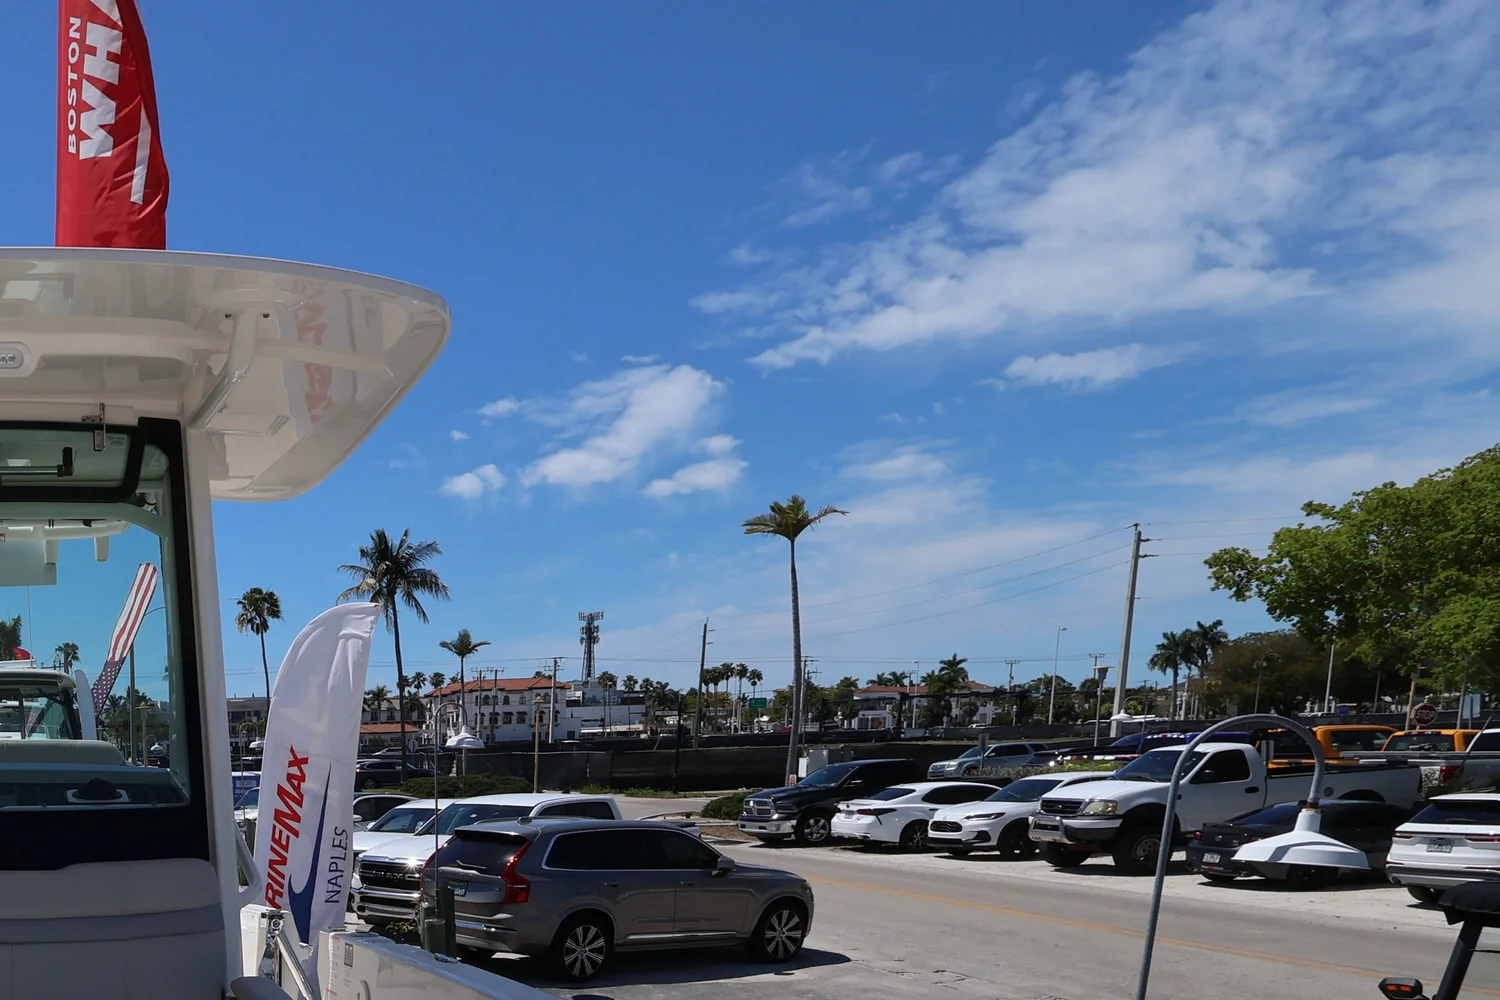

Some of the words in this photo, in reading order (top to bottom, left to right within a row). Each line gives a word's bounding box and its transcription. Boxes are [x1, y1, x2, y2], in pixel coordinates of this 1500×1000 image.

[67, 16, 82, 154] BOSTON
[79, 0, 123, 160] WH
[1415, 709, 1435, 720] STOP
[265, 745, 309, 910] RINEMAX
[324, 826, 348, 904] NAPLES
